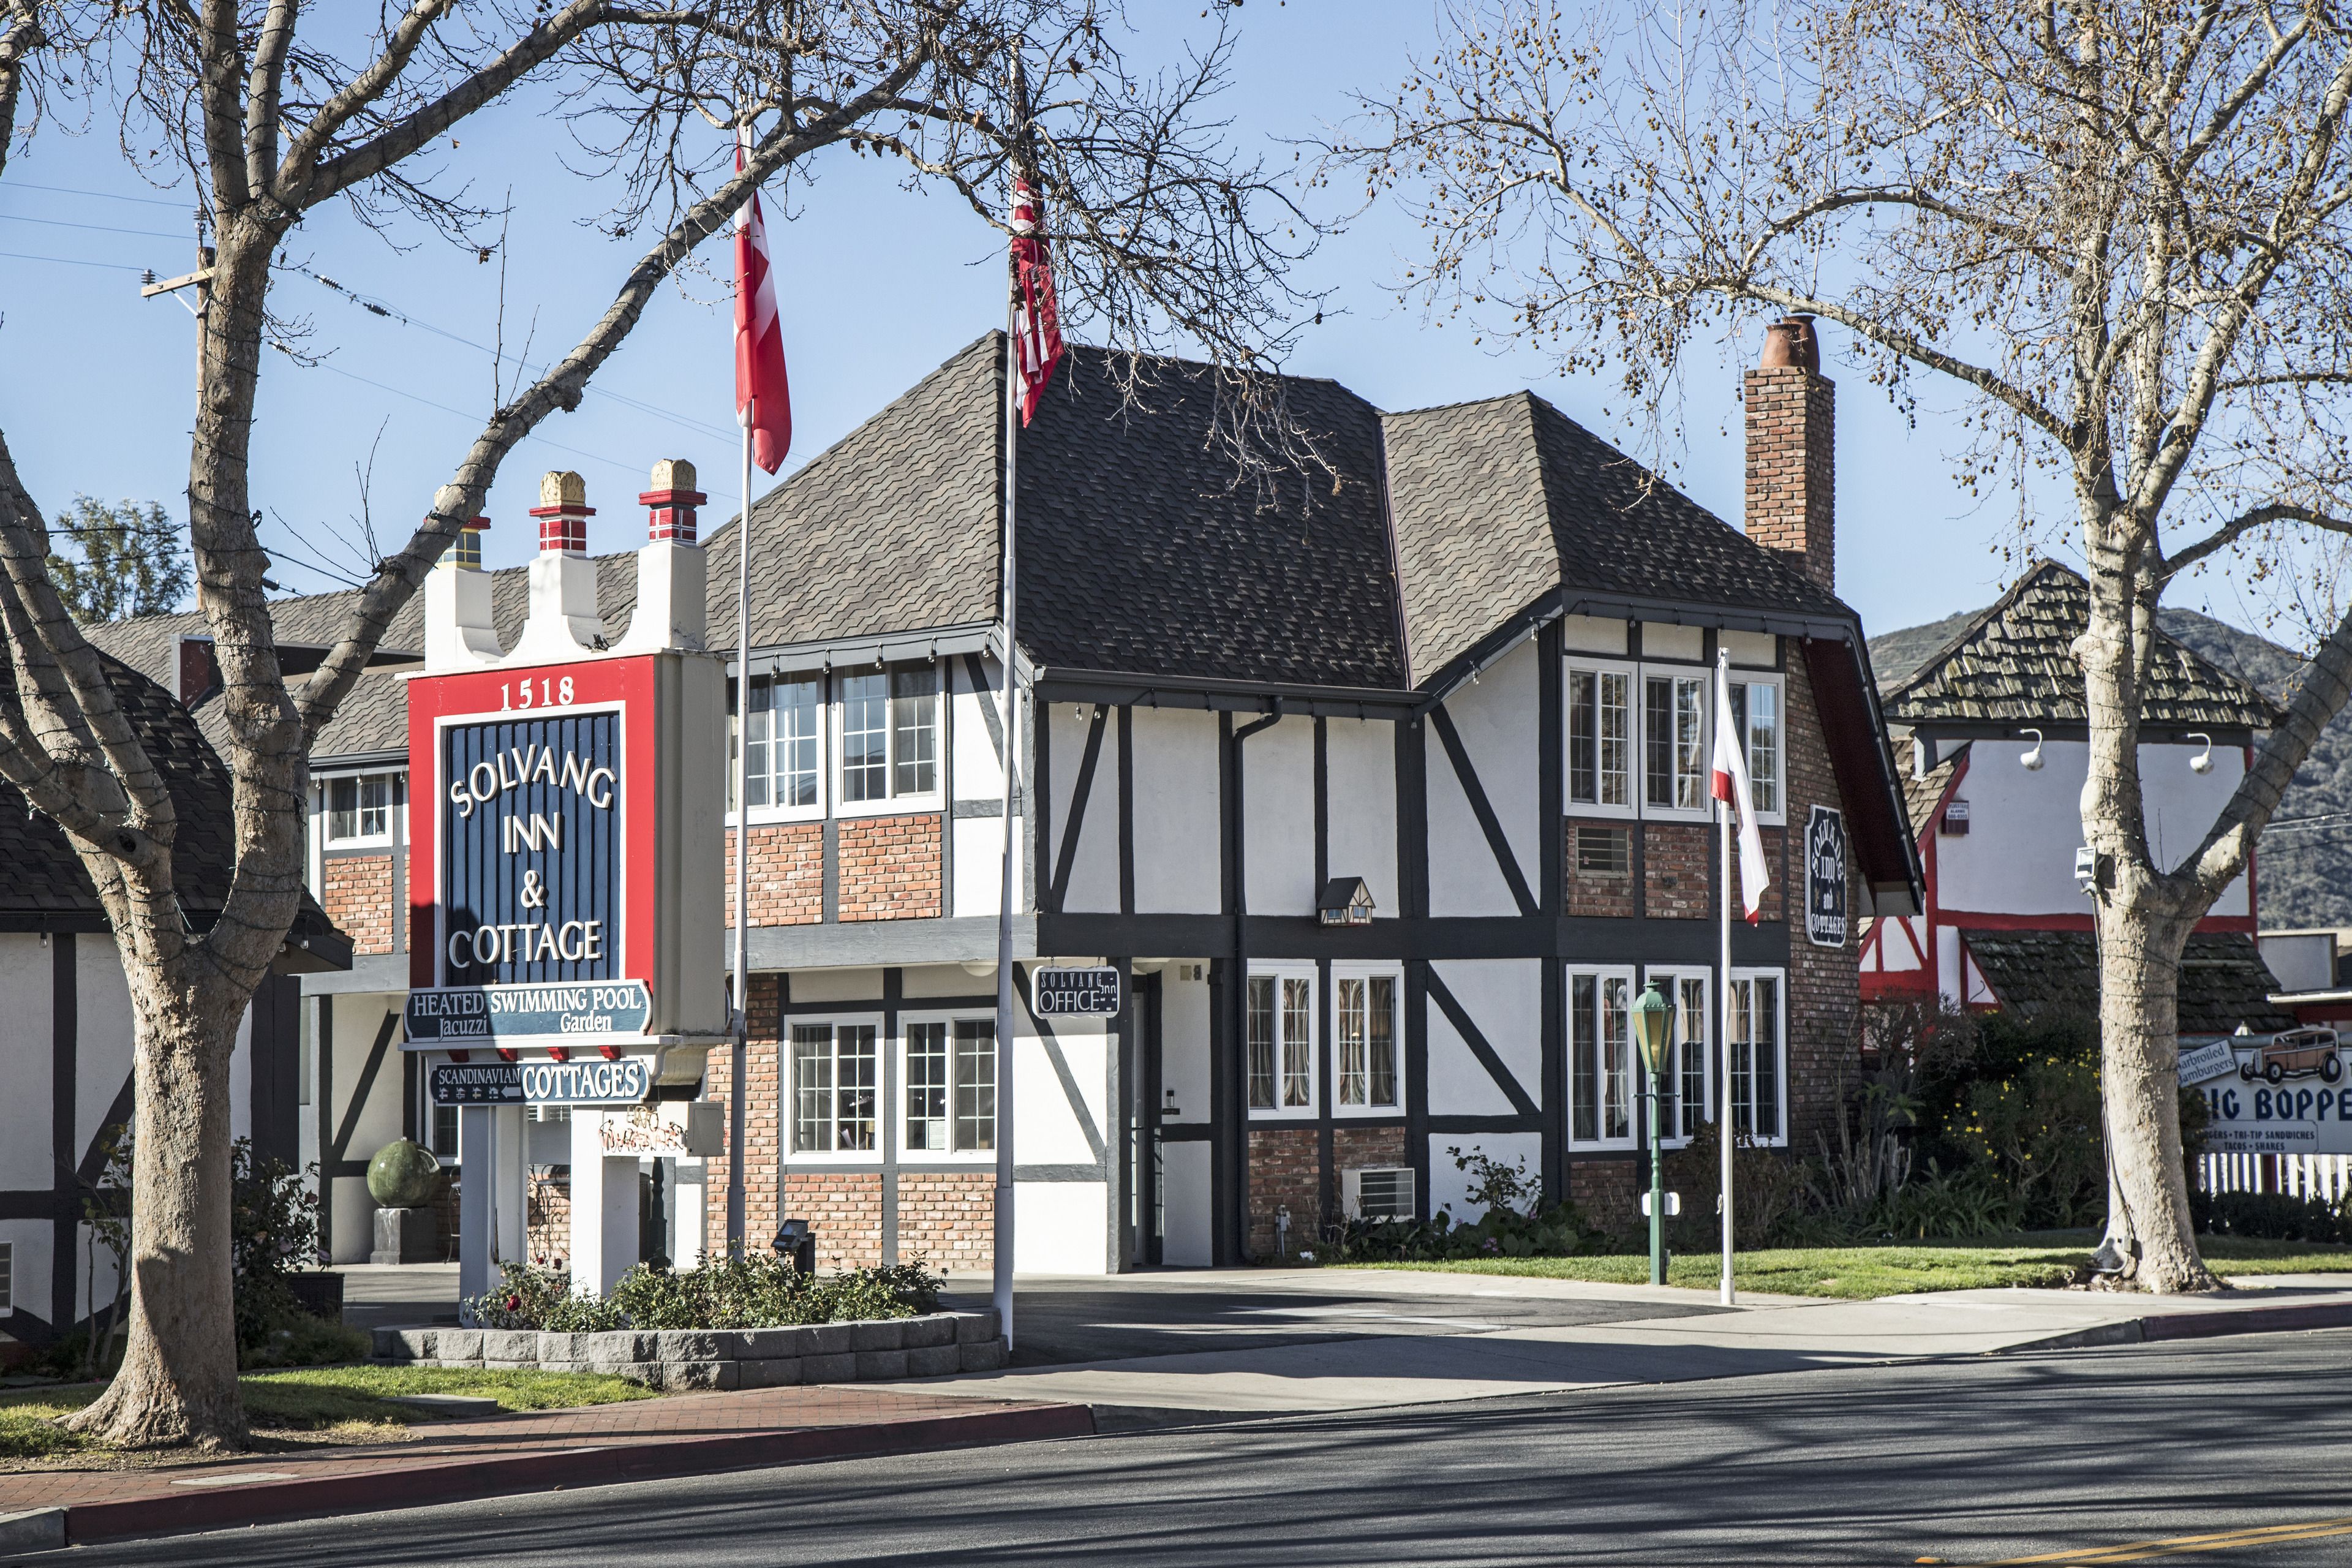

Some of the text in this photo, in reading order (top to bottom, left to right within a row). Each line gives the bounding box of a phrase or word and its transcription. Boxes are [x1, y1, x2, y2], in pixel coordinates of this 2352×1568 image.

[500, 676, 575, 712] 1518
[450, 744, 617, 818] SOLVANG
[504, 812, 560, 854] INN
[1811, 818, 1844, 881] SOLVANG
[520, 870, 545, 908] &
[1823, 888, 1833, 910] and
[1811, 913, 1845, 938] COTTAGES
[448, 920, 601, 968] COTTAGE
[1041, 973, 1101, 988] SOLVANG
[413, 987, 642, 1017] HEATED SWIMMING POOL
[1039, 990, 1100, 1012] OFFICE
[439, 1009, 612, 1041] Jacuzzi Garden
[439, 1063, 640, 1099] SCANDINAVIAN COTTAGES
[2205, 1088, 2241, 1120] IG
[2224, 1142, 2247, 1151] TACOS
[2234, 1131, 2263, 1140] TRI-TIP
[2265, 1131, 2315, 1140] SANDWICHES
